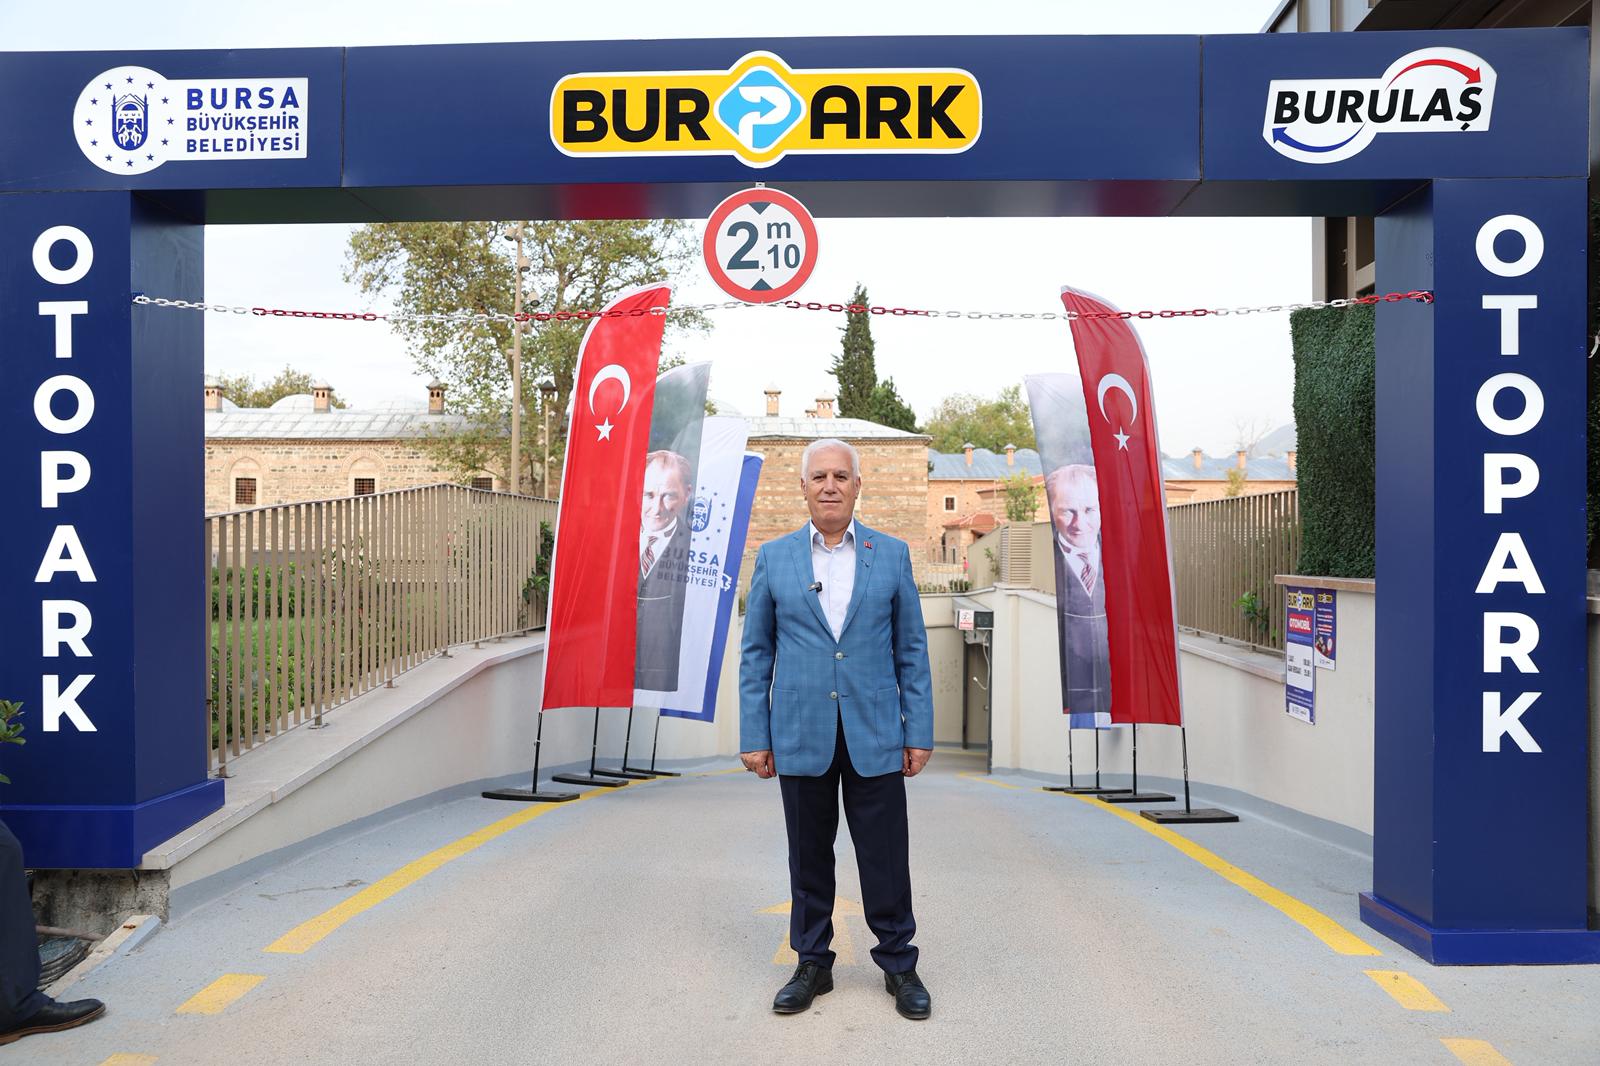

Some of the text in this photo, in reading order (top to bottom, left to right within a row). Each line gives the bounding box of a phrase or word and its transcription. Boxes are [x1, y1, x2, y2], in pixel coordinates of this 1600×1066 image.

[186, 86, 299, 111] BURSA
[1273, 86, 1484, 131] BURULAŞ
[186, 111, 299, 133] BÜYÜKŞEHİR
[186, 133, 299, 153] BELEDİYESİ
[32, 225, 97, 732] OTOPARK
[1475, 214, 1546, 753] OTOPARK
[663, 546, 719, 567] BURSA
